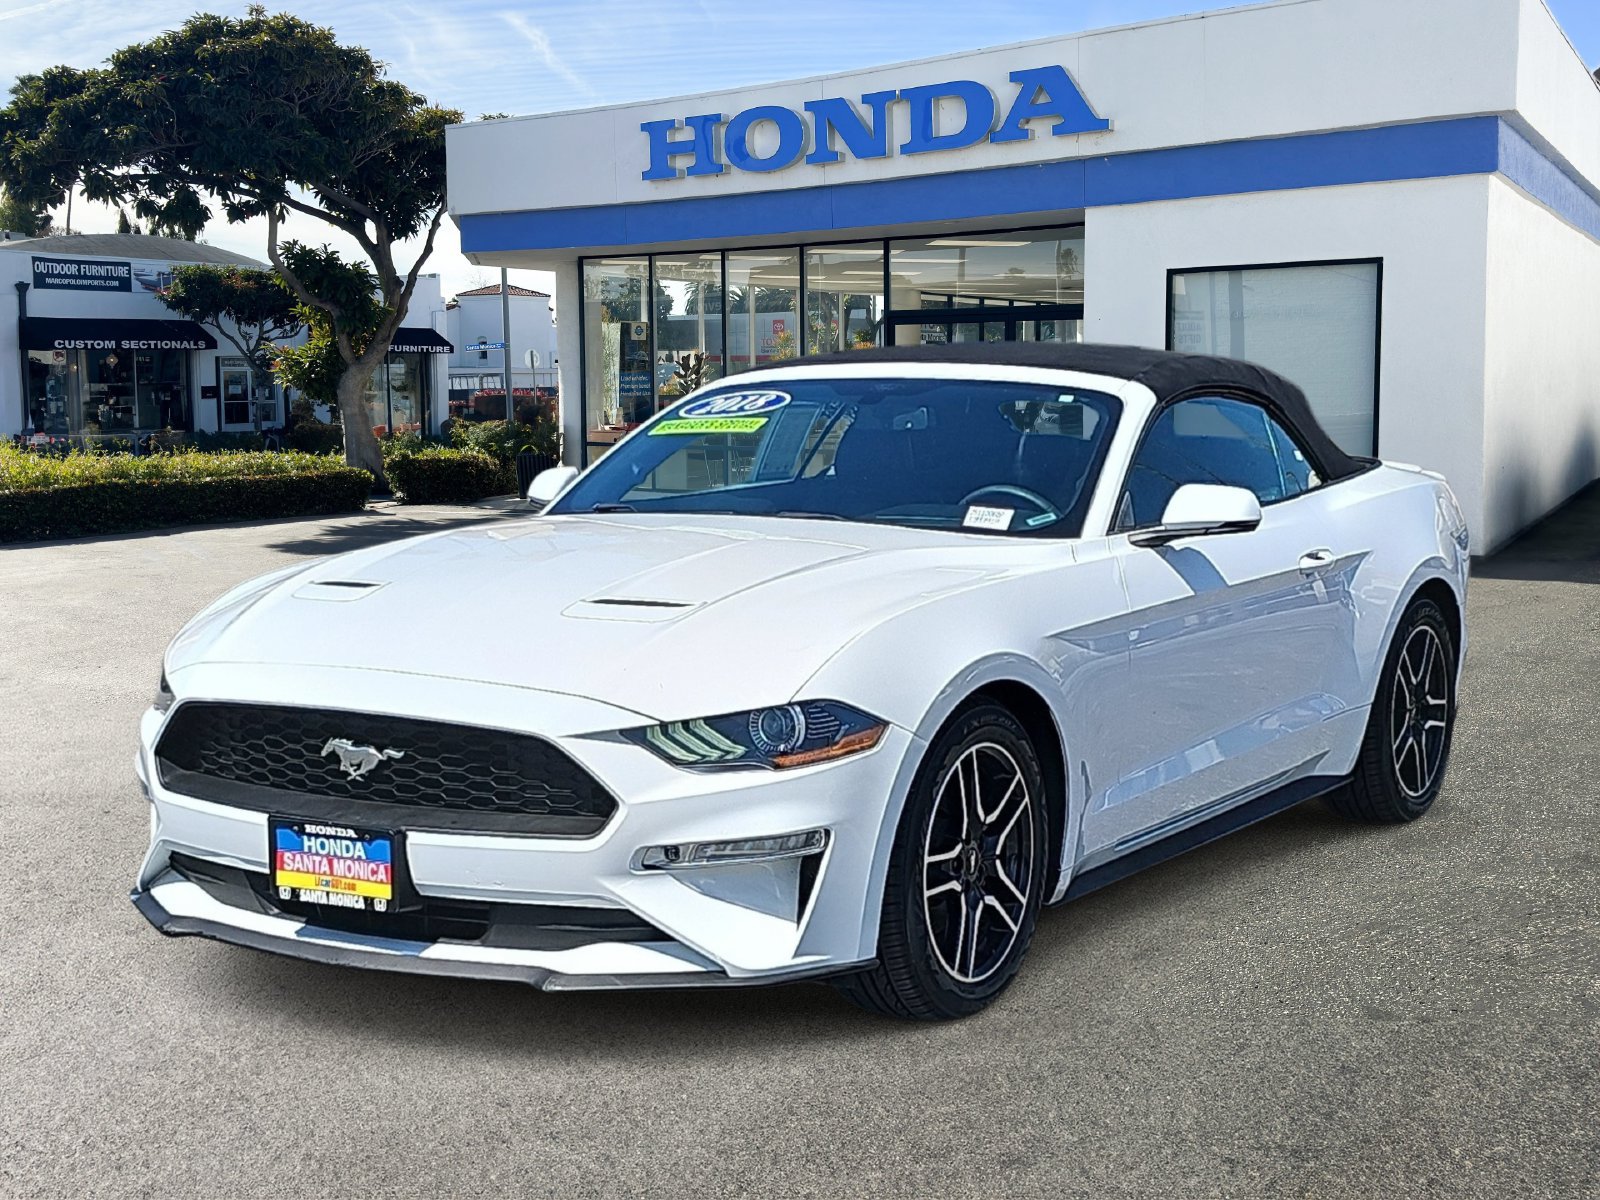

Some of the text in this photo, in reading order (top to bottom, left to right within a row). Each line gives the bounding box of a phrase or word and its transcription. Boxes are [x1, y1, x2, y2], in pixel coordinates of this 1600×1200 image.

[640, 64, 1113, 181] HONDA
[34, 261, 130, 277] OUTDOOR FURNITURE
[45, 277, 119, 287] MARCOPOLOIMPORTS.COM
[54, 339, 206, 349] CUSTOM SECTIONALS
[388, 345, 451, 353] FURNITURE
[691, 394, 778, 415] 2018
[304, 824, 358, 838] HONDA
[303, 835, 367, 859] HONDA
[283, 853, 387, 883] SANTA MONICA
[299, 889, 366, 910] SANTA MONICA
